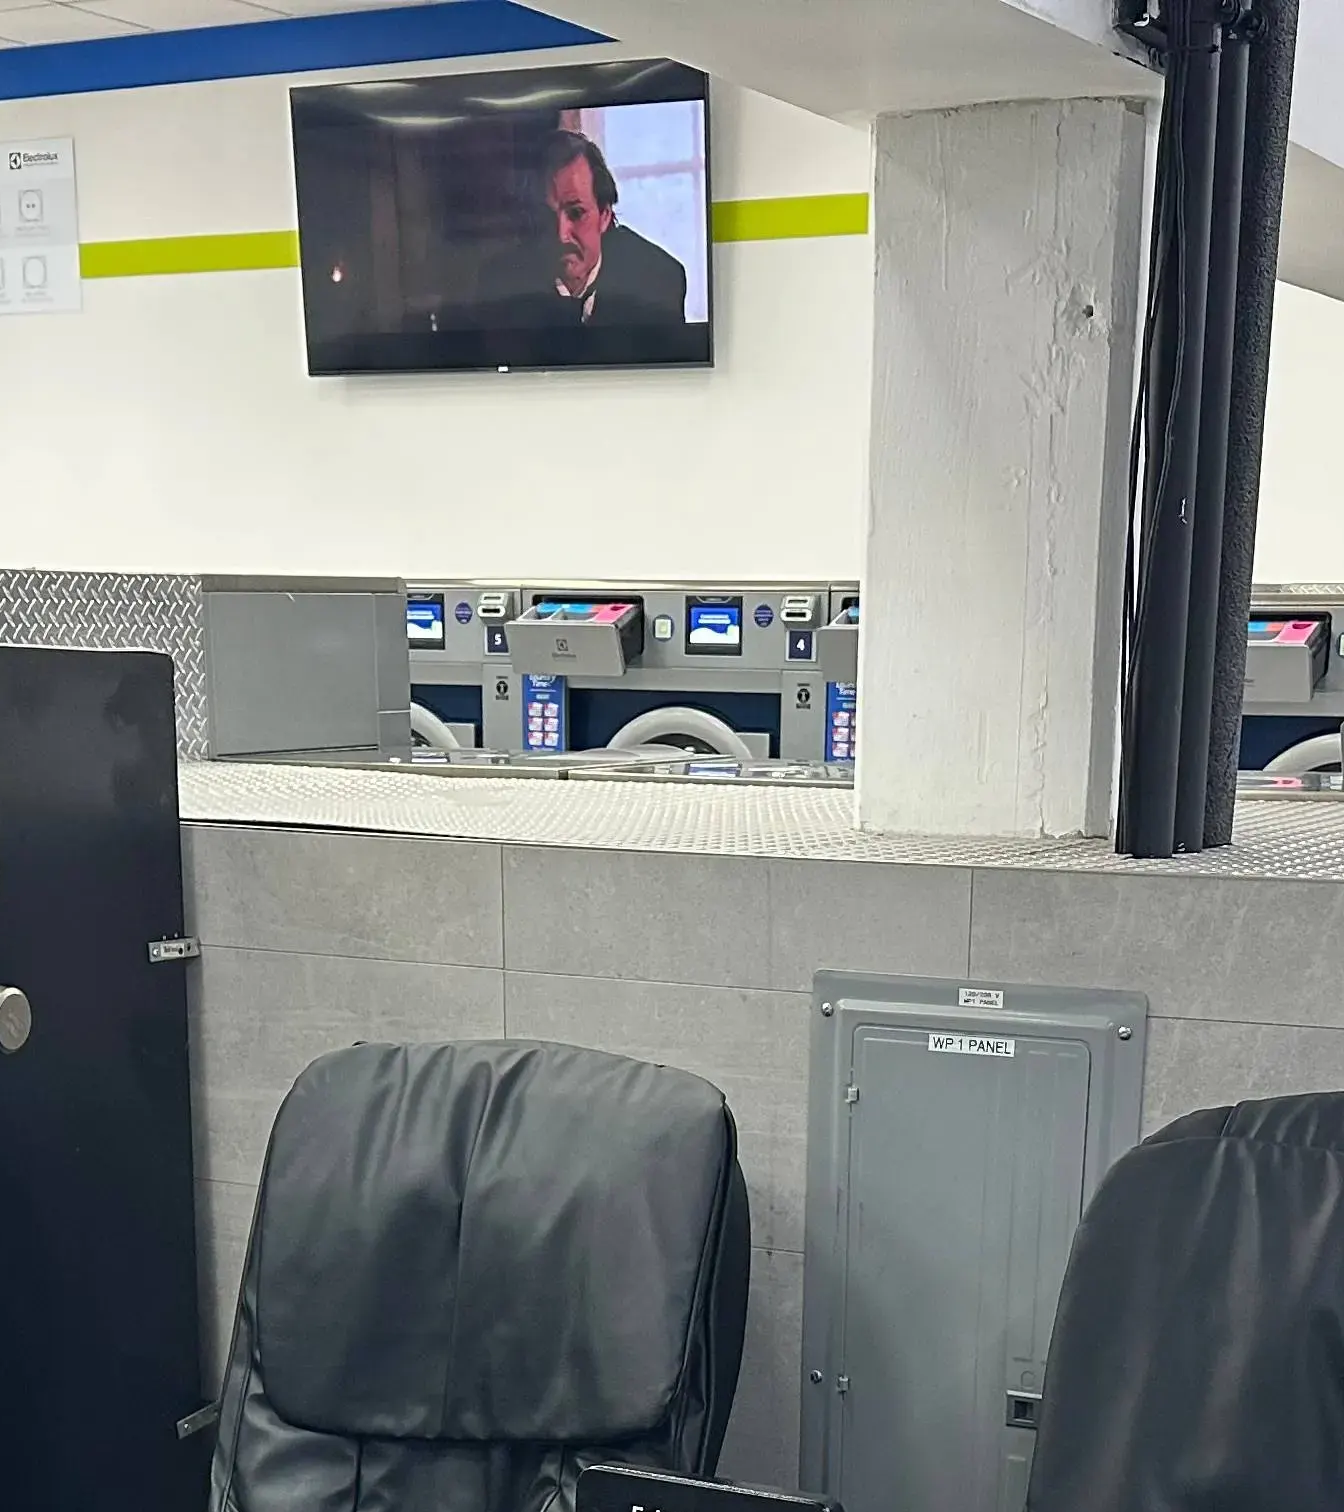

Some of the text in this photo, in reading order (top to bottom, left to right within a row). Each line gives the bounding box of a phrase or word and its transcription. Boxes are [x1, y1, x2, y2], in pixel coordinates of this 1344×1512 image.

[494, 633, 502, 646] 5
[796, 638, 806, 651] 4
[933, 1037, 1012, 1055] WP 1 PANEL
